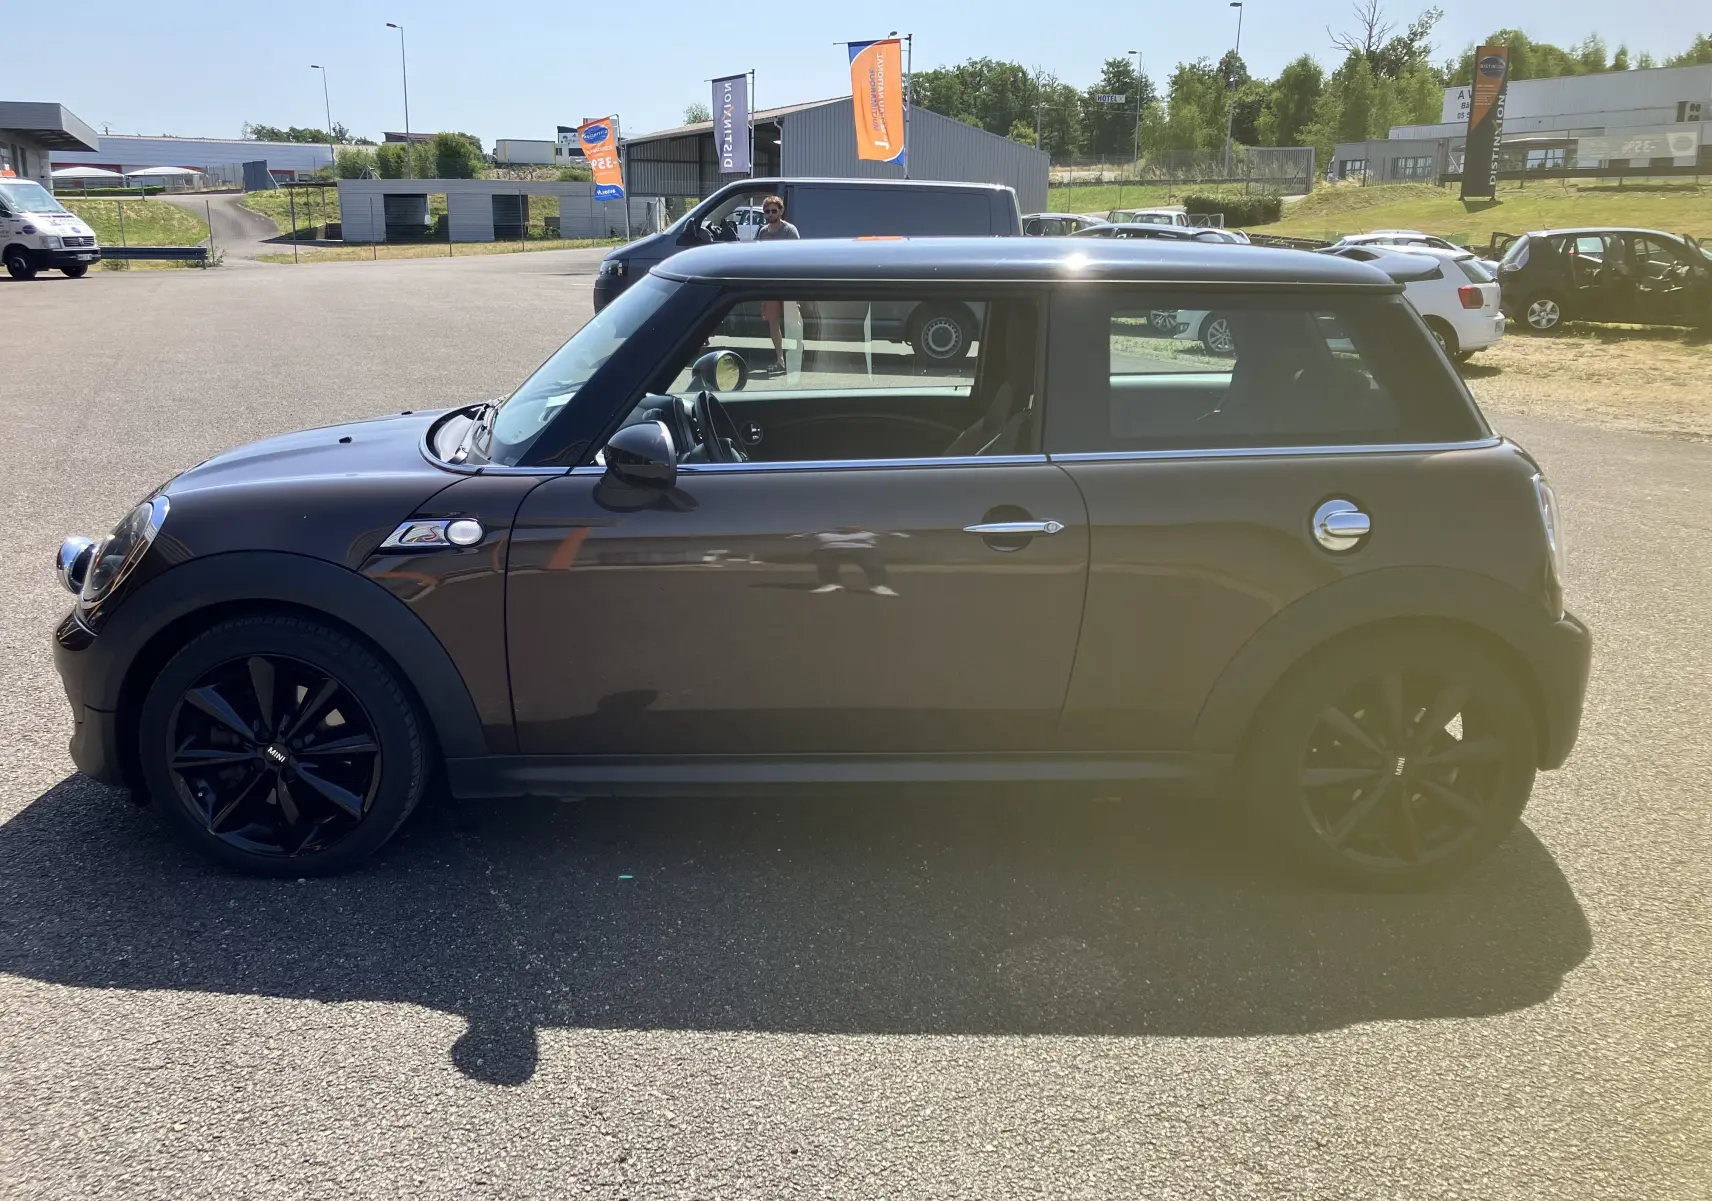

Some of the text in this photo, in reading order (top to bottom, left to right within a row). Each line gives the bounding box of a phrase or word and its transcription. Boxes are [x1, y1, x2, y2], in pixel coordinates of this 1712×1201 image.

[1489, 95, 1506, 186] DISTINXION
[267, 746, 286, 763] MINI
[1394, 757, 1406, 776] MINI
